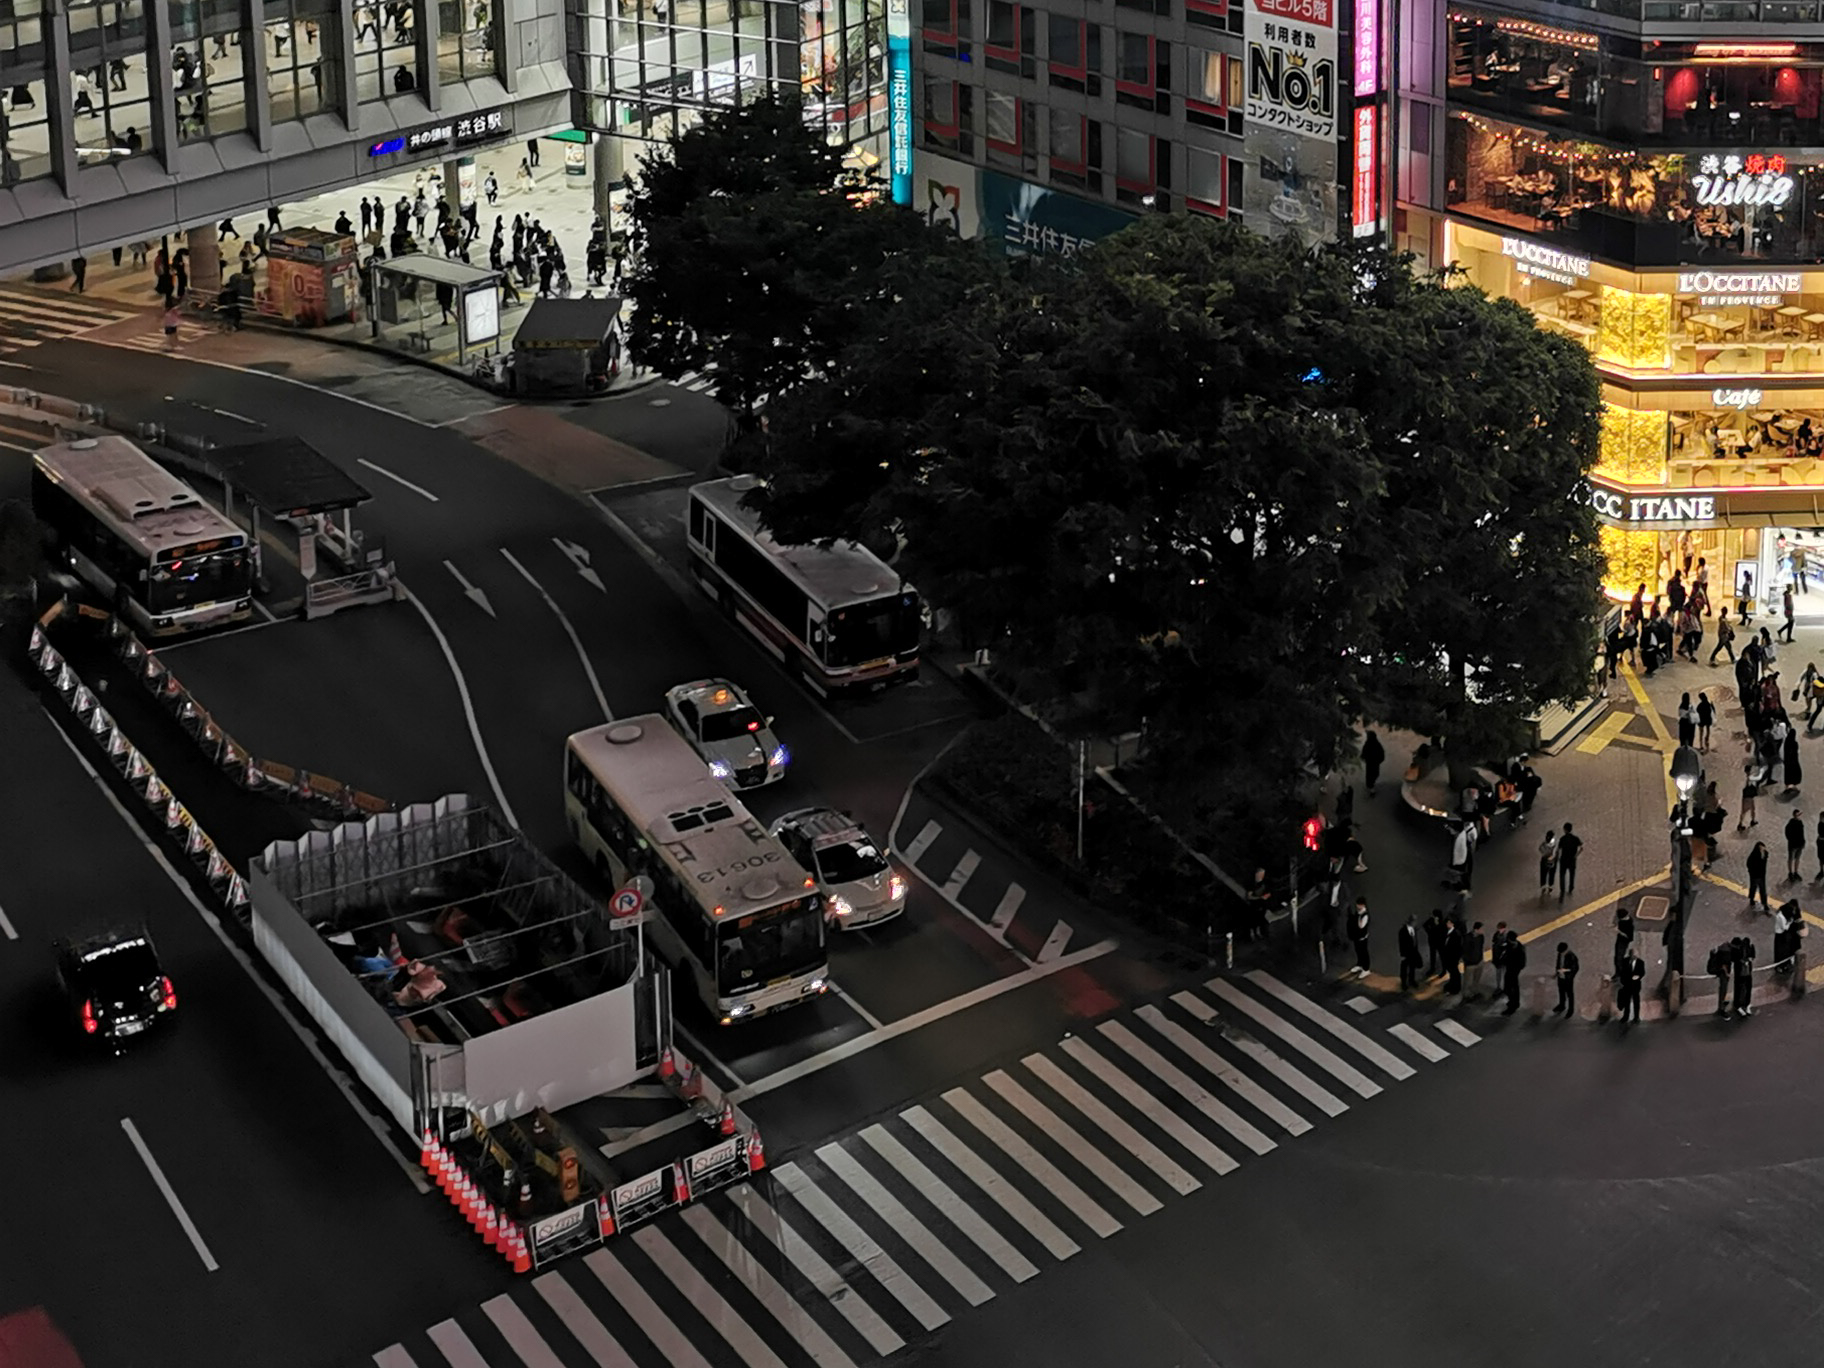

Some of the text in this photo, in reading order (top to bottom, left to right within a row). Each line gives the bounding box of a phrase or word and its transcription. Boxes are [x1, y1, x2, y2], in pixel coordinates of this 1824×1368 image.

[1264, 22, 1317, 49] 利用者数
[1250, 41, 1333, 119] No.1
[457, 112, 502, 137] 渋谷駅
[893, 68, 909, 175] 三井住友信託銀行
[1247, 103, 1333, 136] コンタクトショップ
[1502, 237, 1589, 277] L'OCCITANE
[1680, 273, 1801, 293] L'OCCITANE
[1712, 388, 1761, 409] Café
[697, 851, 781, 884] 30613
